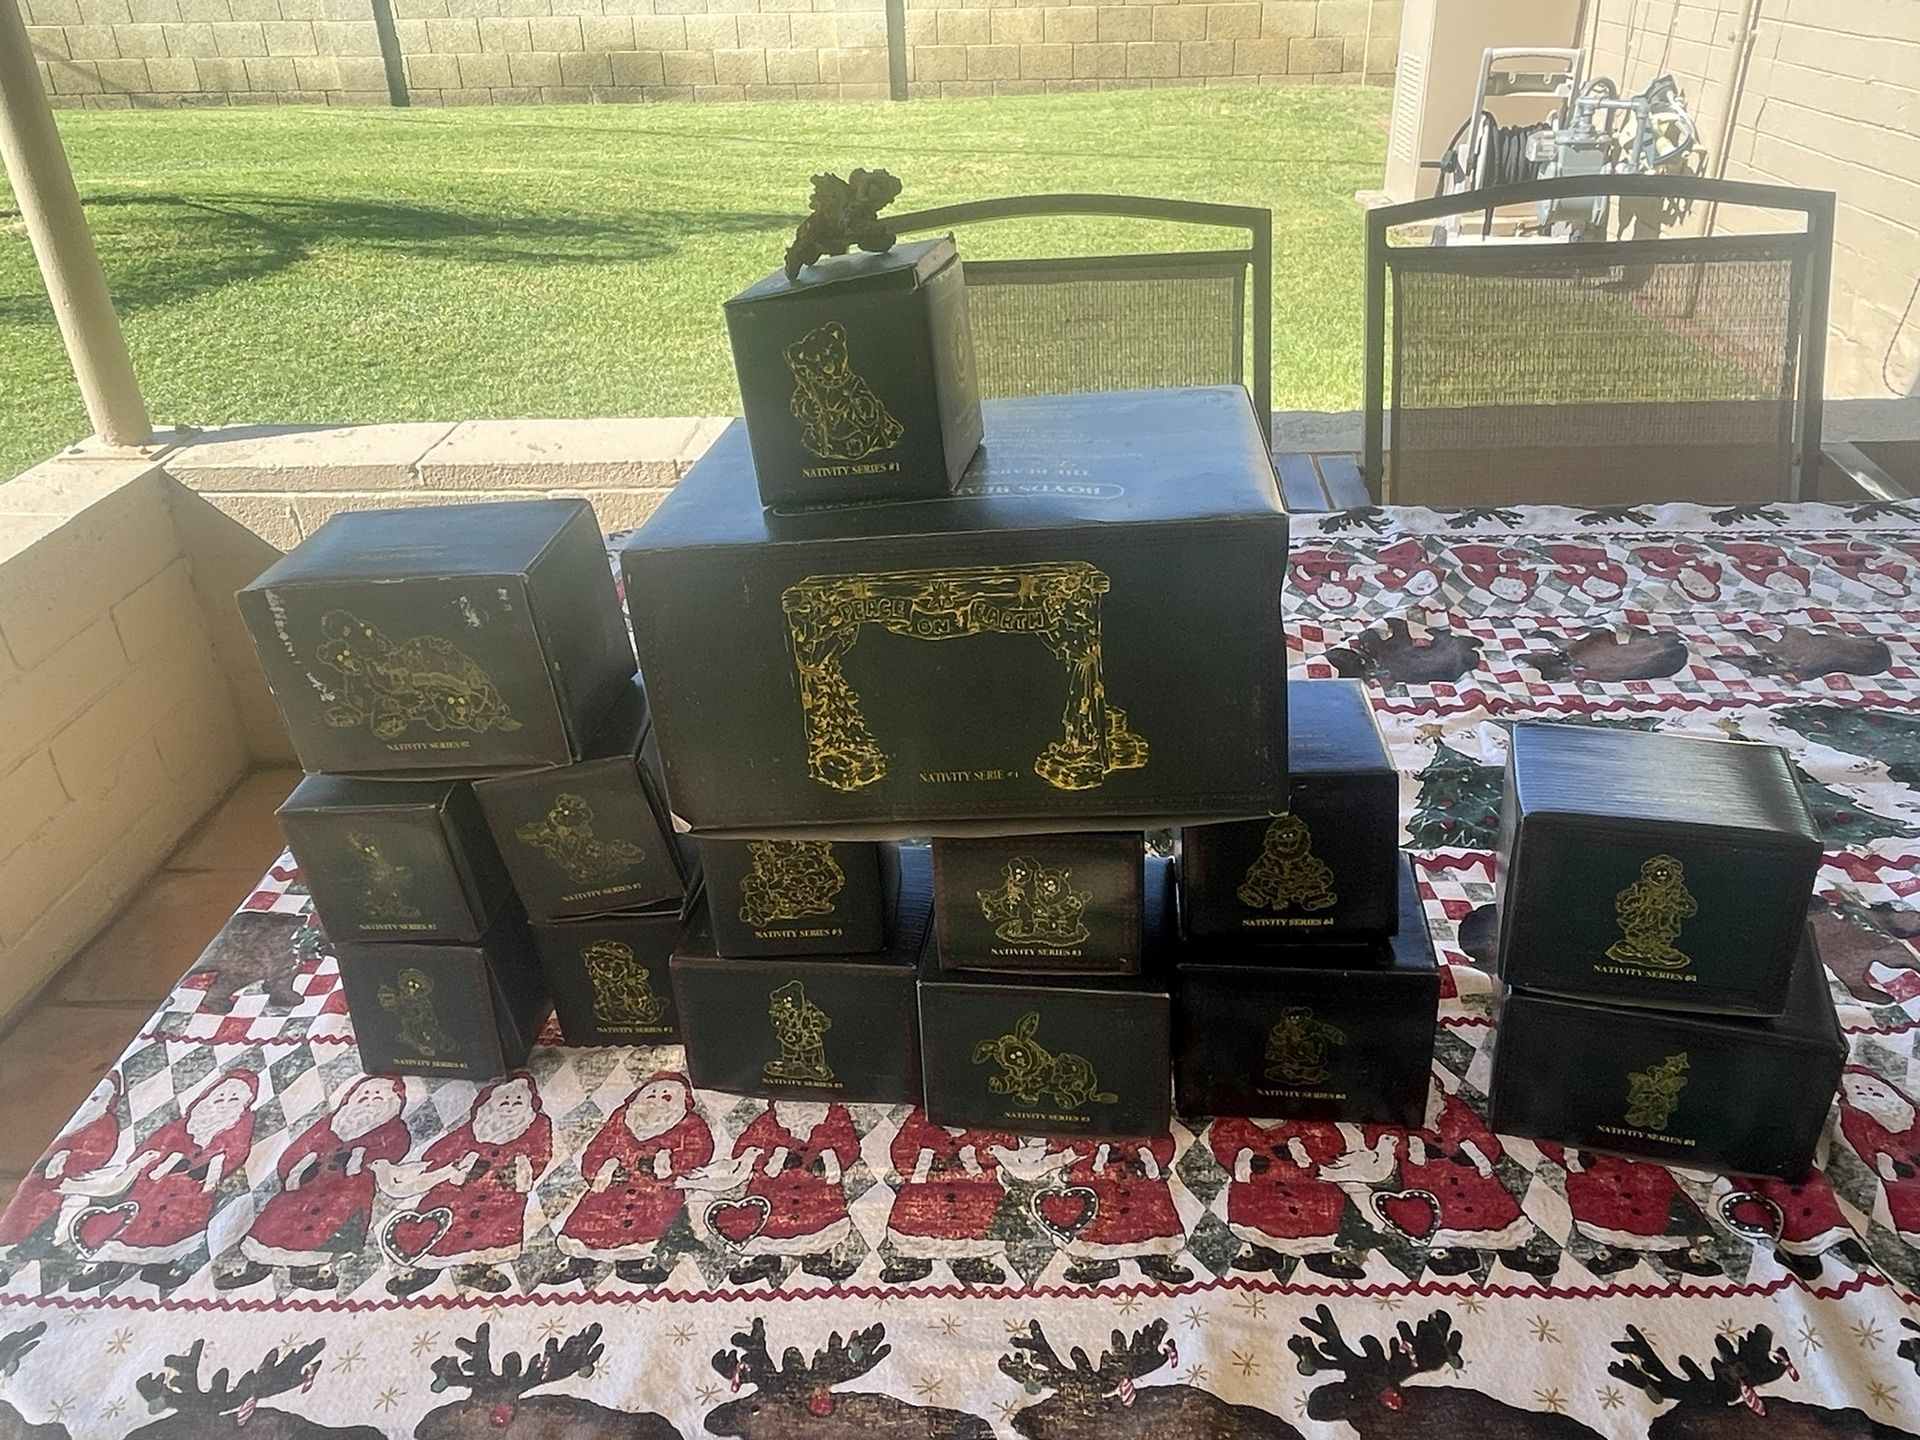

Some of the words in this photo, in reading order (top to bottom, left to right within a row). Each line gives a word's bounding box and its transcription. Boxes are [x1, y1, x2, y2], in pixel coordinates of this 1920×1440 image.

[802, 467, 849, 478] NATIVITY
[851, 463, 886, 475] SERIES
[889, 462, 900, 472] #1
[840, 600, 905, 623] PEACE
[917, 616, 950, 635] ON
[974, 602, 1043, 629] EARTH
[387, 742, 428, 751] NATIVITY
[430, 741, 460, 750] SERIES
[919, 771, 971, 783] NATIVITY
[561, 890, 601, 902] NATIVITY
[602, 884, 632, 895] SERIES
[399, 923, 427, 931] SERIES
[1242, 918, 1287, 926] NATIVITY
[1288, 918, 1322, 926] SERIES
[755, 930, 797, 938] NATIVITY
[799, 929, 830, 937] SERIES
[991, 948, 1035, 956] NATIVITY
[1038, 948, 1070, 956] SERIES
[1593, 964, 1643, 976] NATIVITY
[1646, 970, 1683, 980] SERIES
[393, 1058, 431, 1066] NATIVITY
[432, 1060, 458, 1068] SERIES
[762, 1078, 802, 1086] NATIVITY
[804, 1079, 833, 1087] SERIES
[1256, 1088, 1300, 1097] NATIVITY
[1005, 1111, 1046, 1119] NATIVITY
[1048, 1113, 1079, 1121] SERIES
[1597, 1125, 1644, 1138] NATIVITY
[1647, 1132, 1682, 1144] SERIES
